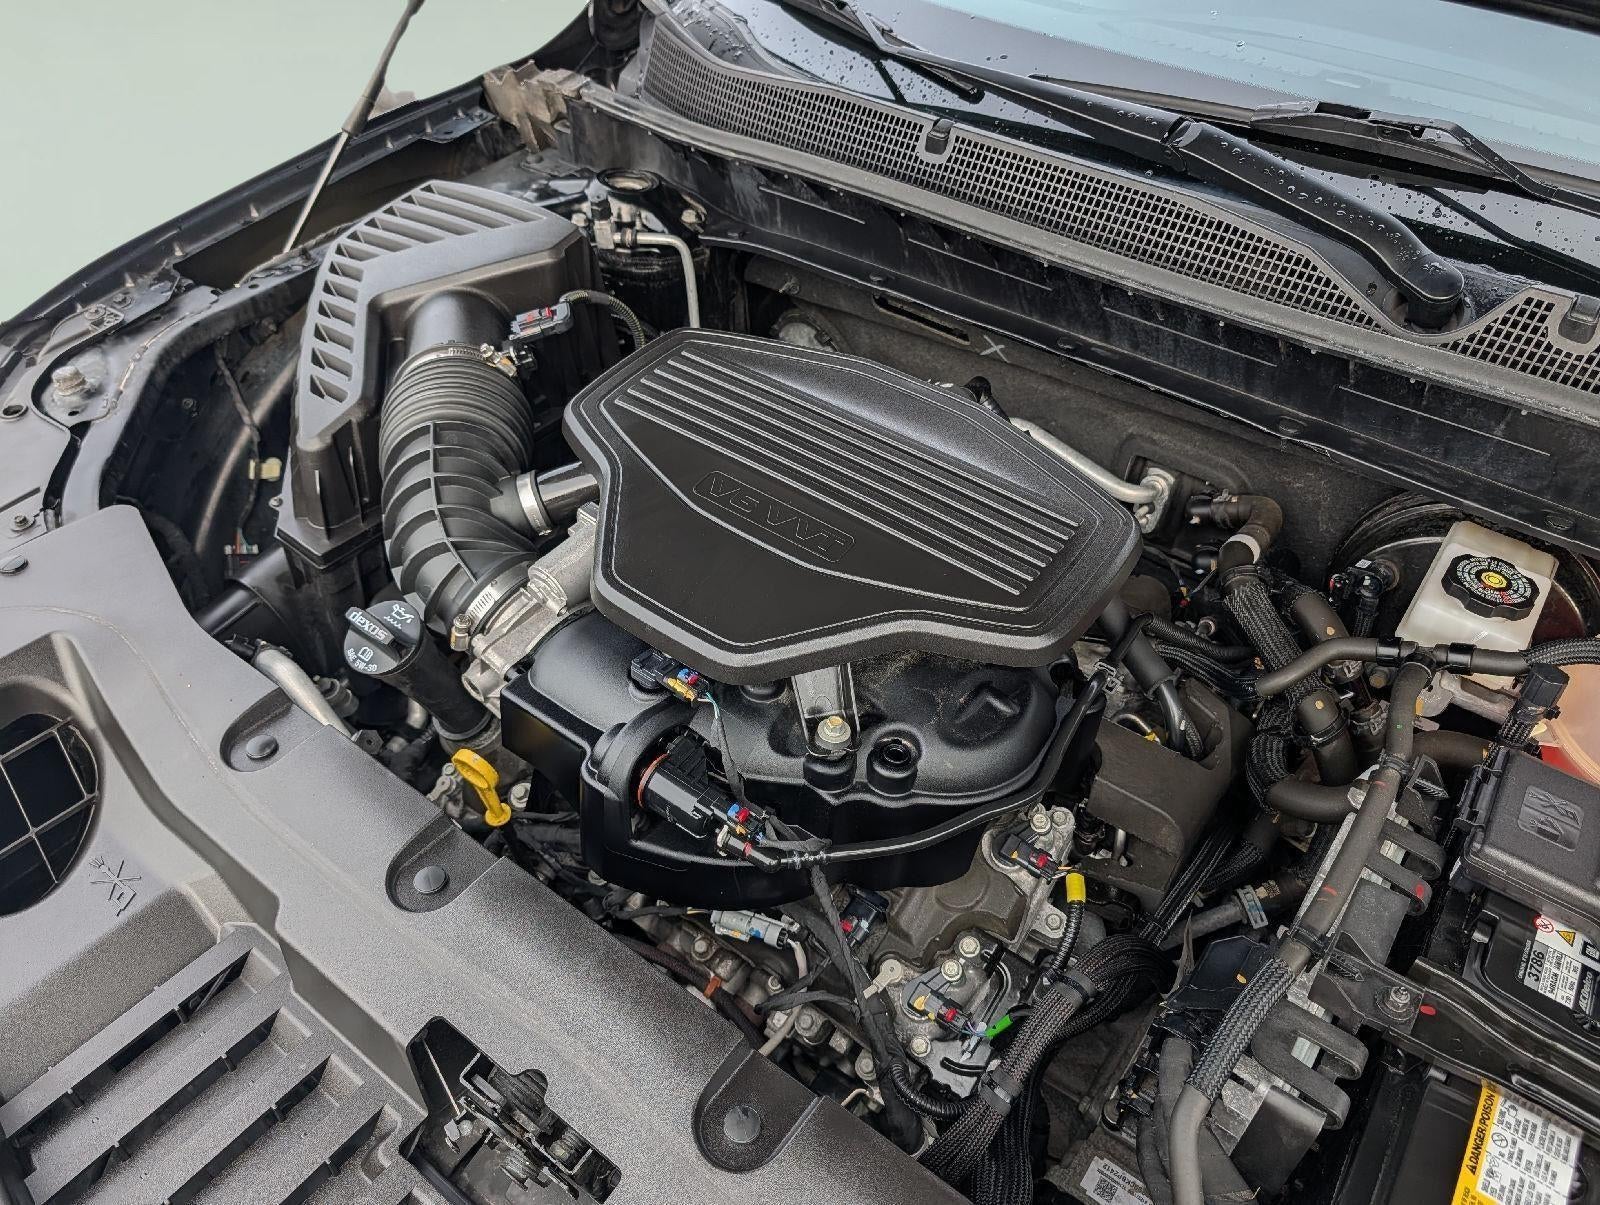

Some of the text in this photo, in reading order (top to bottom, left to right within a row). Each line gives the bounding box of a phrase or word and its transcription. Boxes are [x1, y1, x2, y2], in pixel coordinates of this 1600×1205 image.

[709, 477, 760, 513] V6
[349, 611, 388, 641] dexos
[1527, 949, 1545, 983] 3786
[1578, 971, 1594, 1011] ACDelco
[1469, 1092, 1497, 1165] DANGER/POISON
